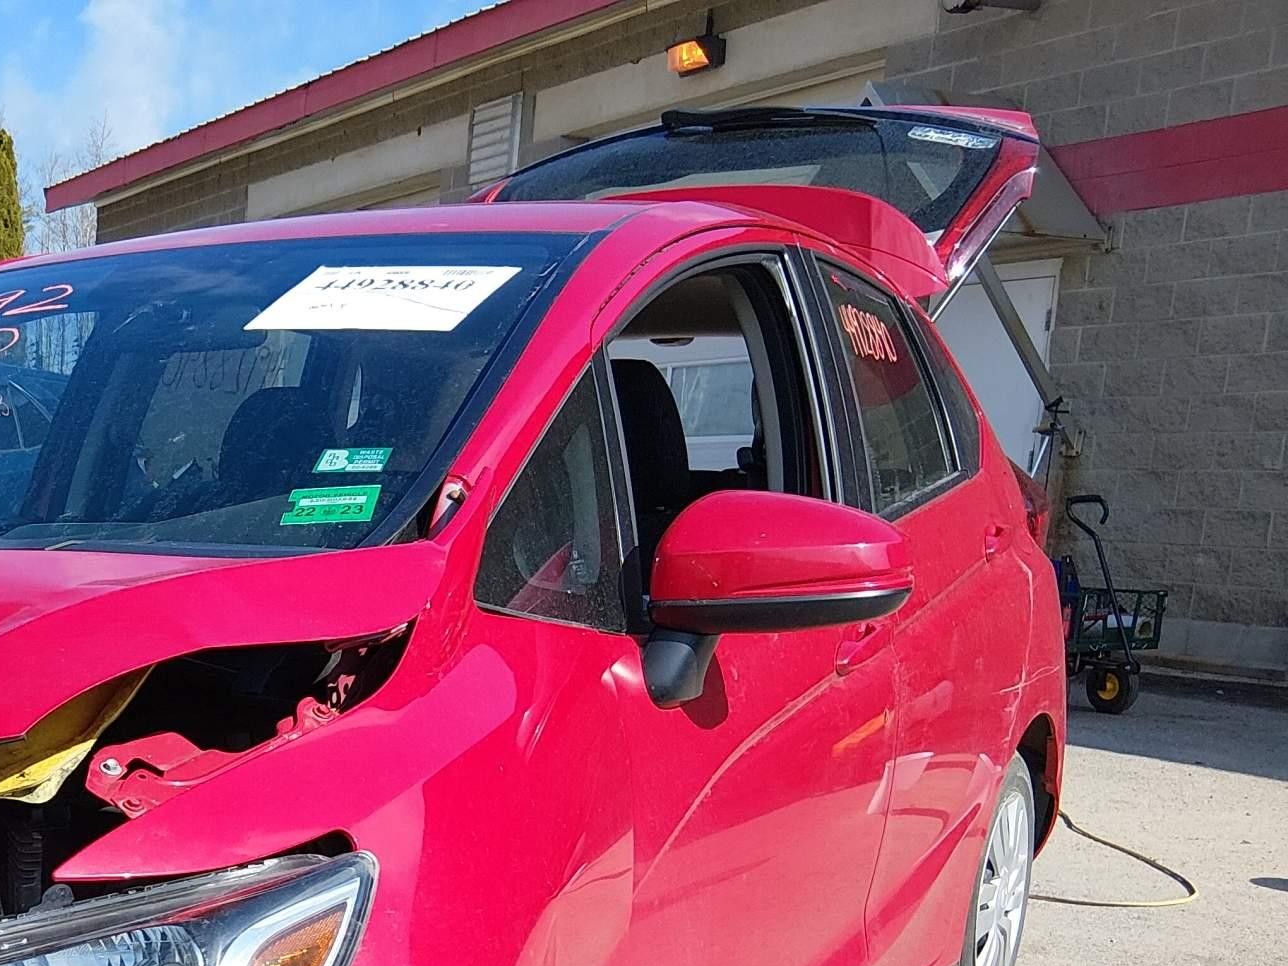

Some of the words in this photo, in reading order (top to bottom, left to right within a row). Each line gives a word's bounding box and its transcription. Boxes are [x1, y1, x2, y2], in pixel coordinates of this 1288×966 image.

[315, 278, 475, 291] 44928840
[294, 506, 316, 517] 22
[340, 504, 364, 515] 23
